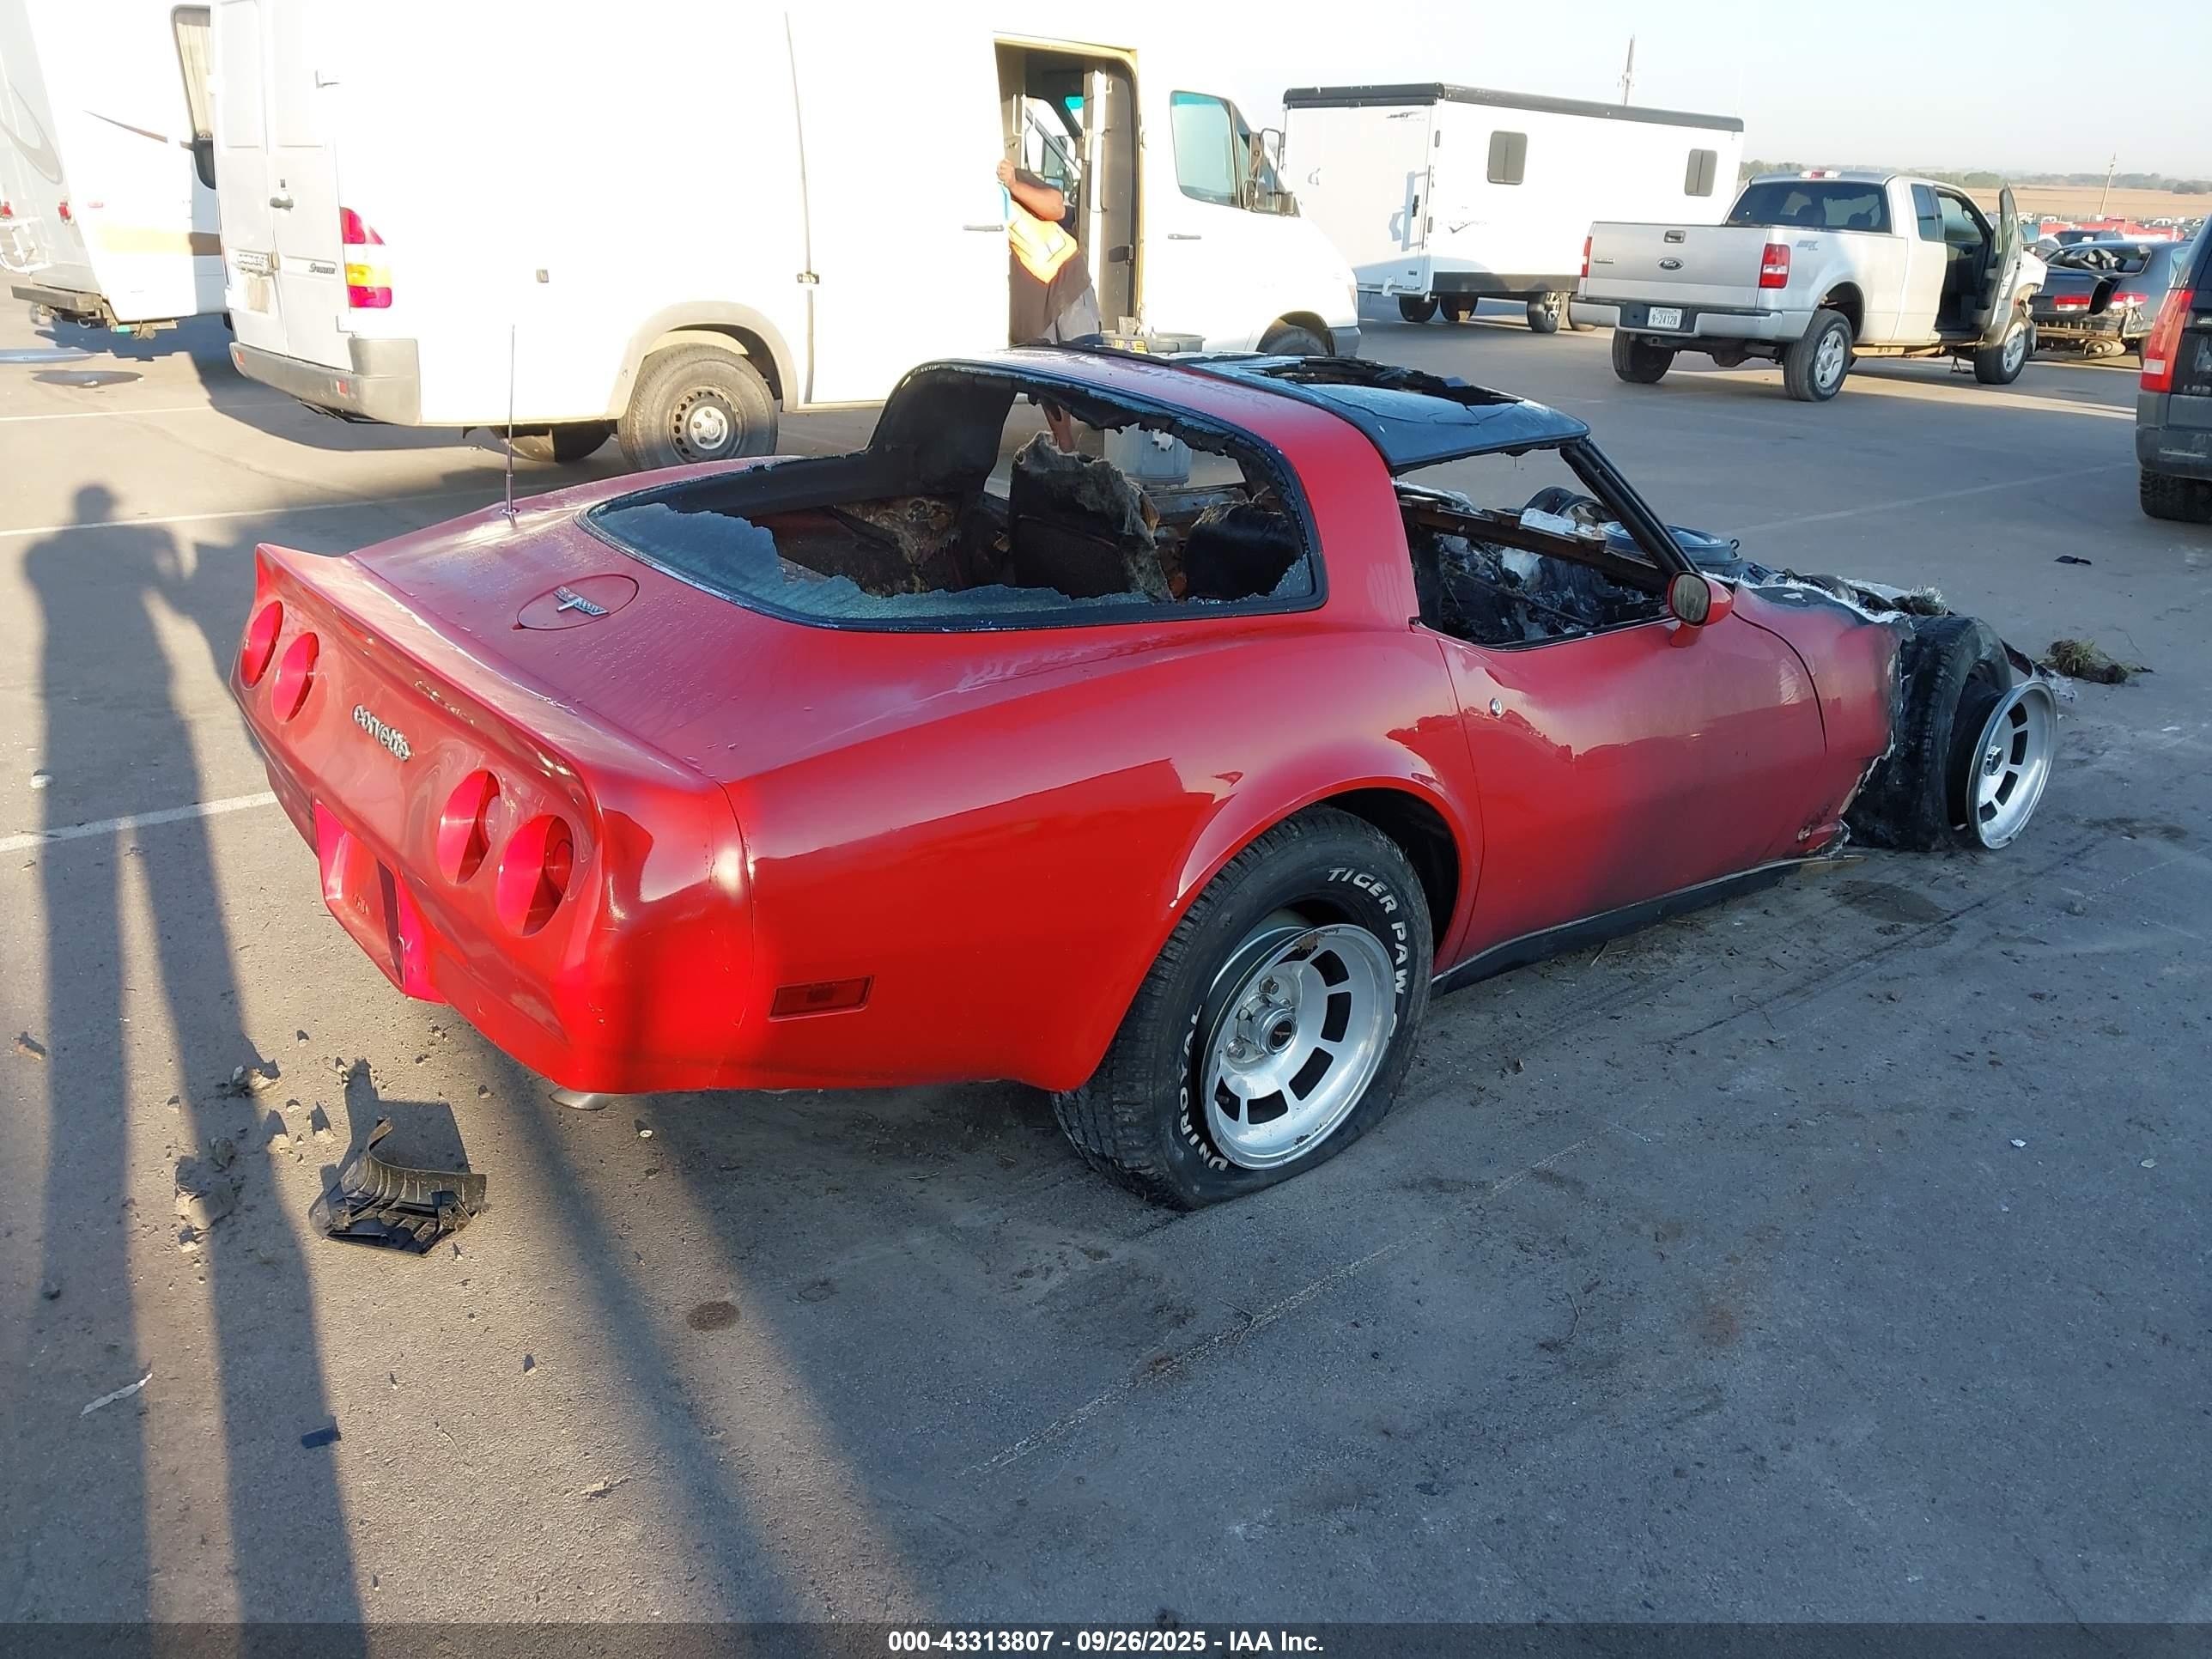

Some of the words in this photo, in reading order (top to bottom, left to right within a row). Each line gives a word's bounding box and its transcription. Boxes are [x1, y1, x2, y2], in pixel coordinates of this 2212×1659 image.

[1327, 867, 1399, 915] TIGER
[1391, 921, 1409, 994] PAW
[1179, 1005, 1229, 1172] UNIROYAL
